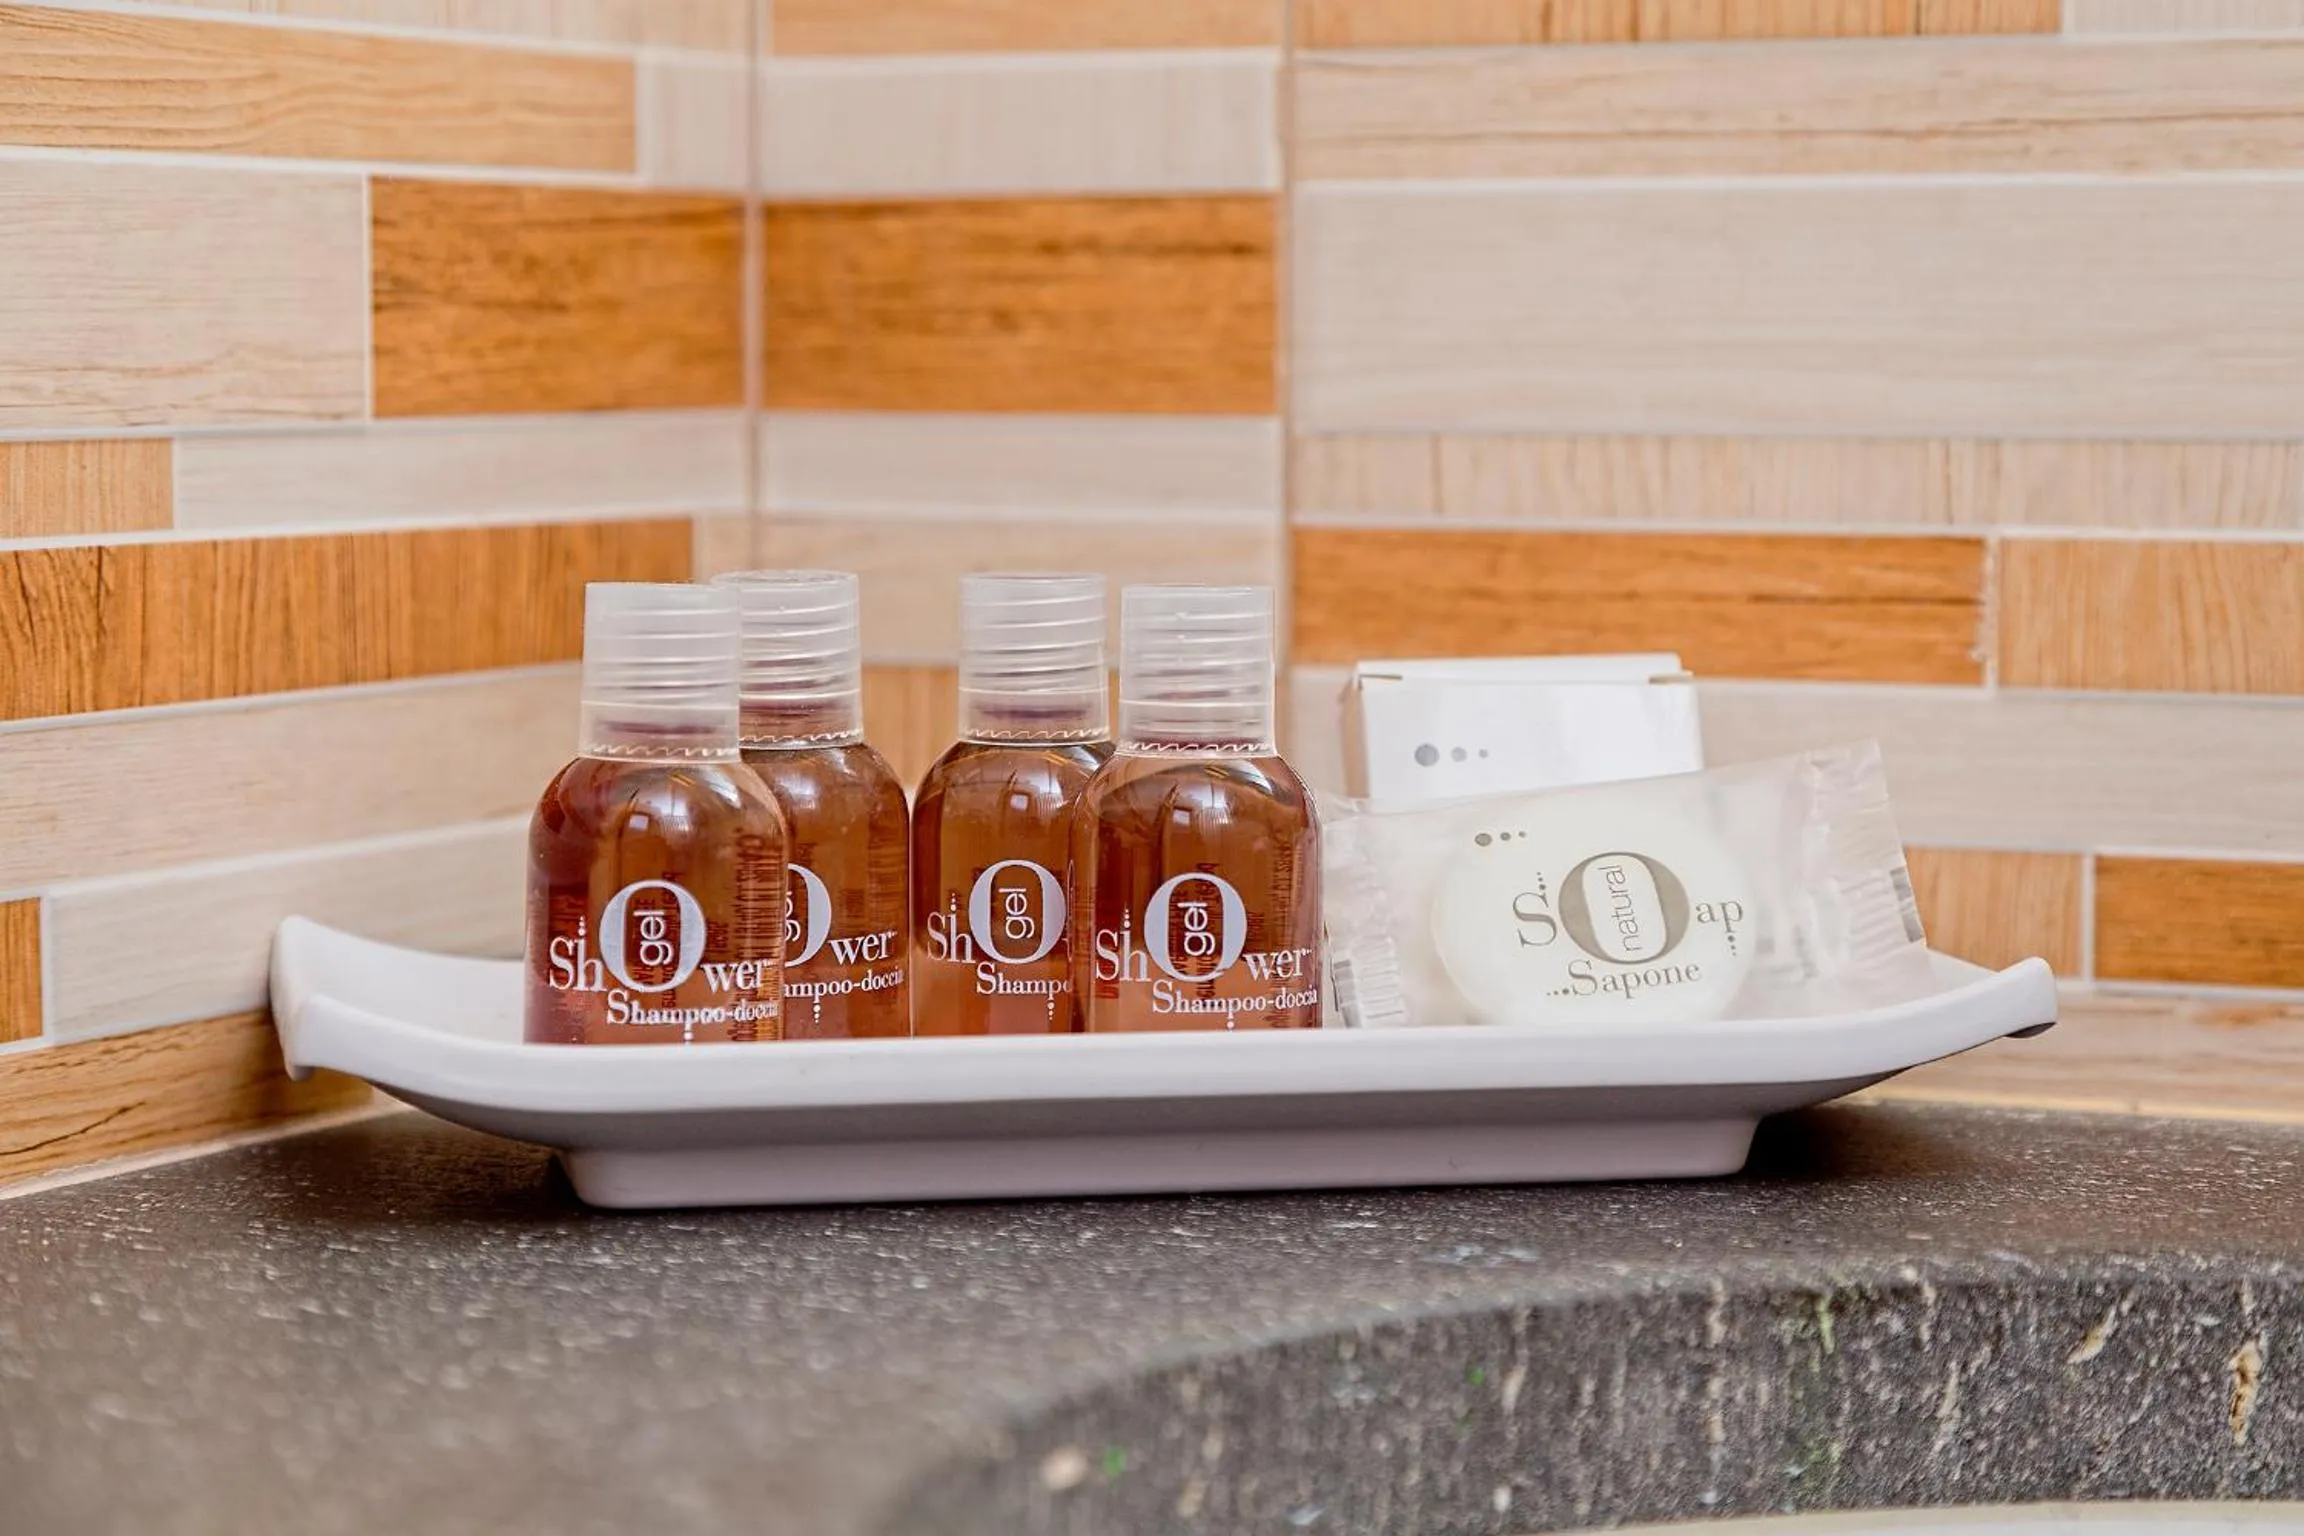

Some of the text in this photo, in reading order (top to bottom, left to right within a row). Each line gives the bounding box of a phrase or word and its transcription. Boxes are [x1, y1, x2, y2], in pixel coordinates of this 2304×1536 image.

[999, 887, 1035, 939] gel
[1178, 902, 1216, 956] gel
[1598, 864, 1643, 952] natural
[633, 910, 674, 966] gel
[1568, 959, 1701, 998] Sapone
